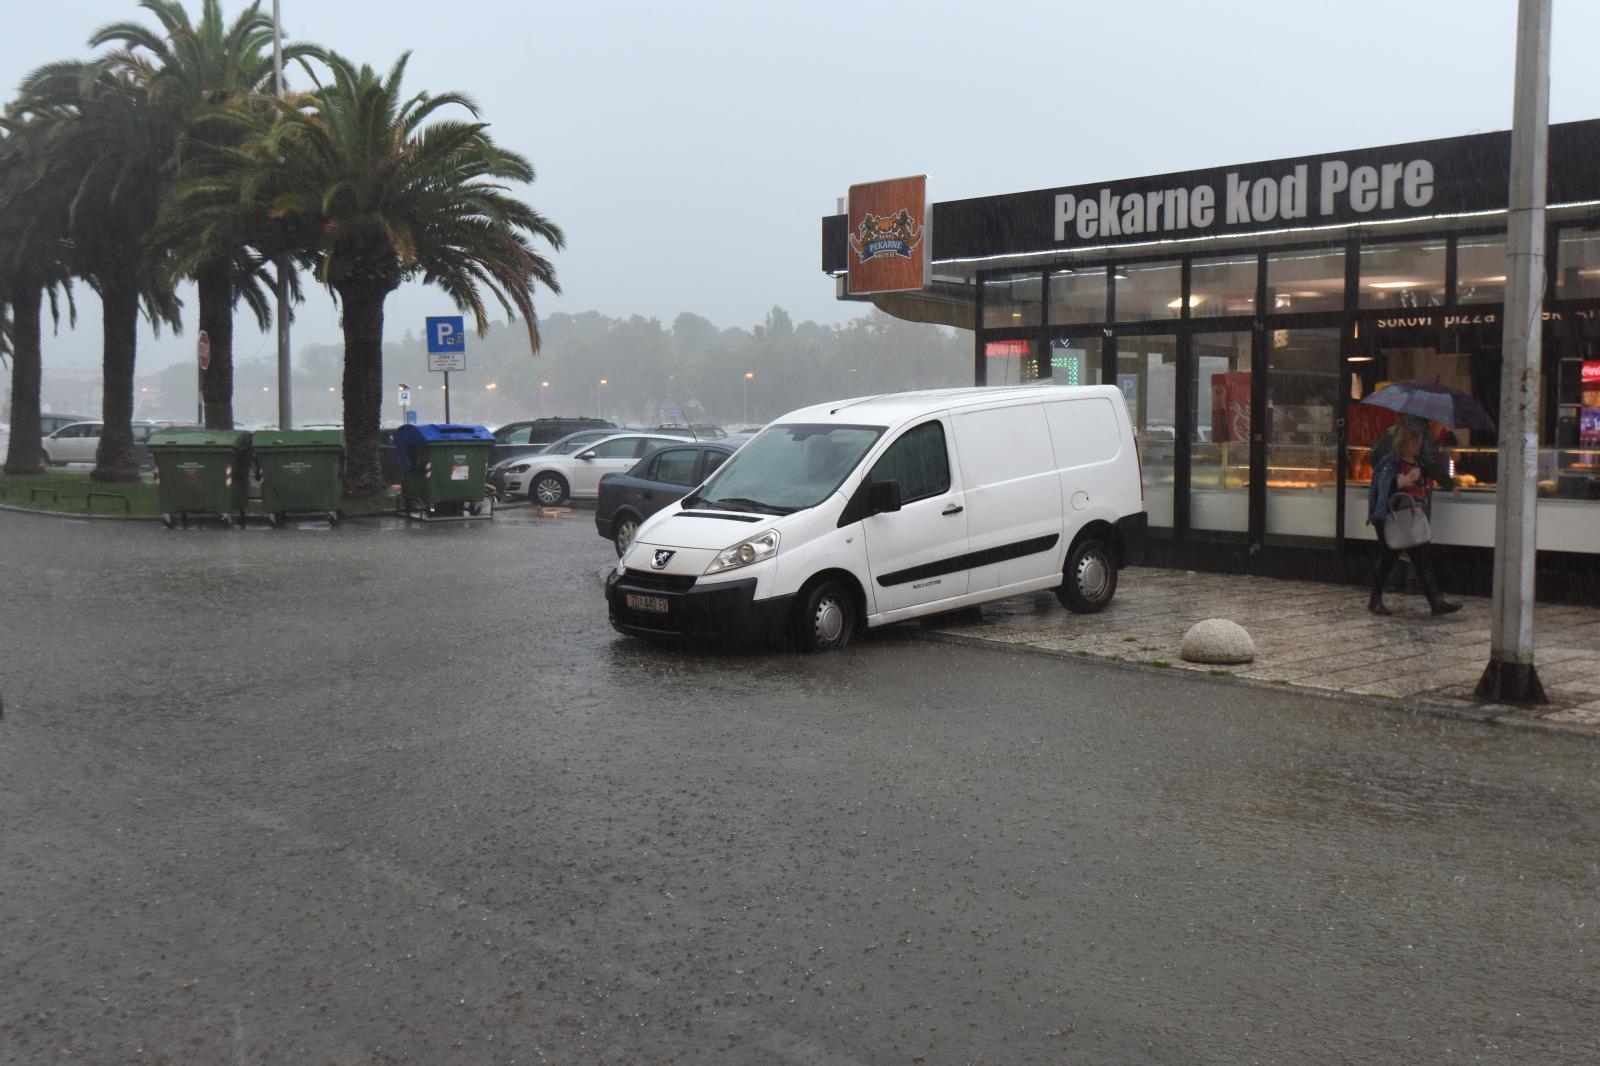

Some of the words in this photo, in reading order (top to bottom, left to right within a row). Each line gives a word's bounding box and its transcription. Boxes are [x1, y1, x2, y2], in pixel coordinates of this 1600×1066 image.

[1054, 183, 1215, 241] Pekarne
[1226, 164, 1308, 225] kod
[1320, 159, 1434, 216] Pere
[870, 241, 903, 251] PEKARNE
[437, 323, 453, 345] P
